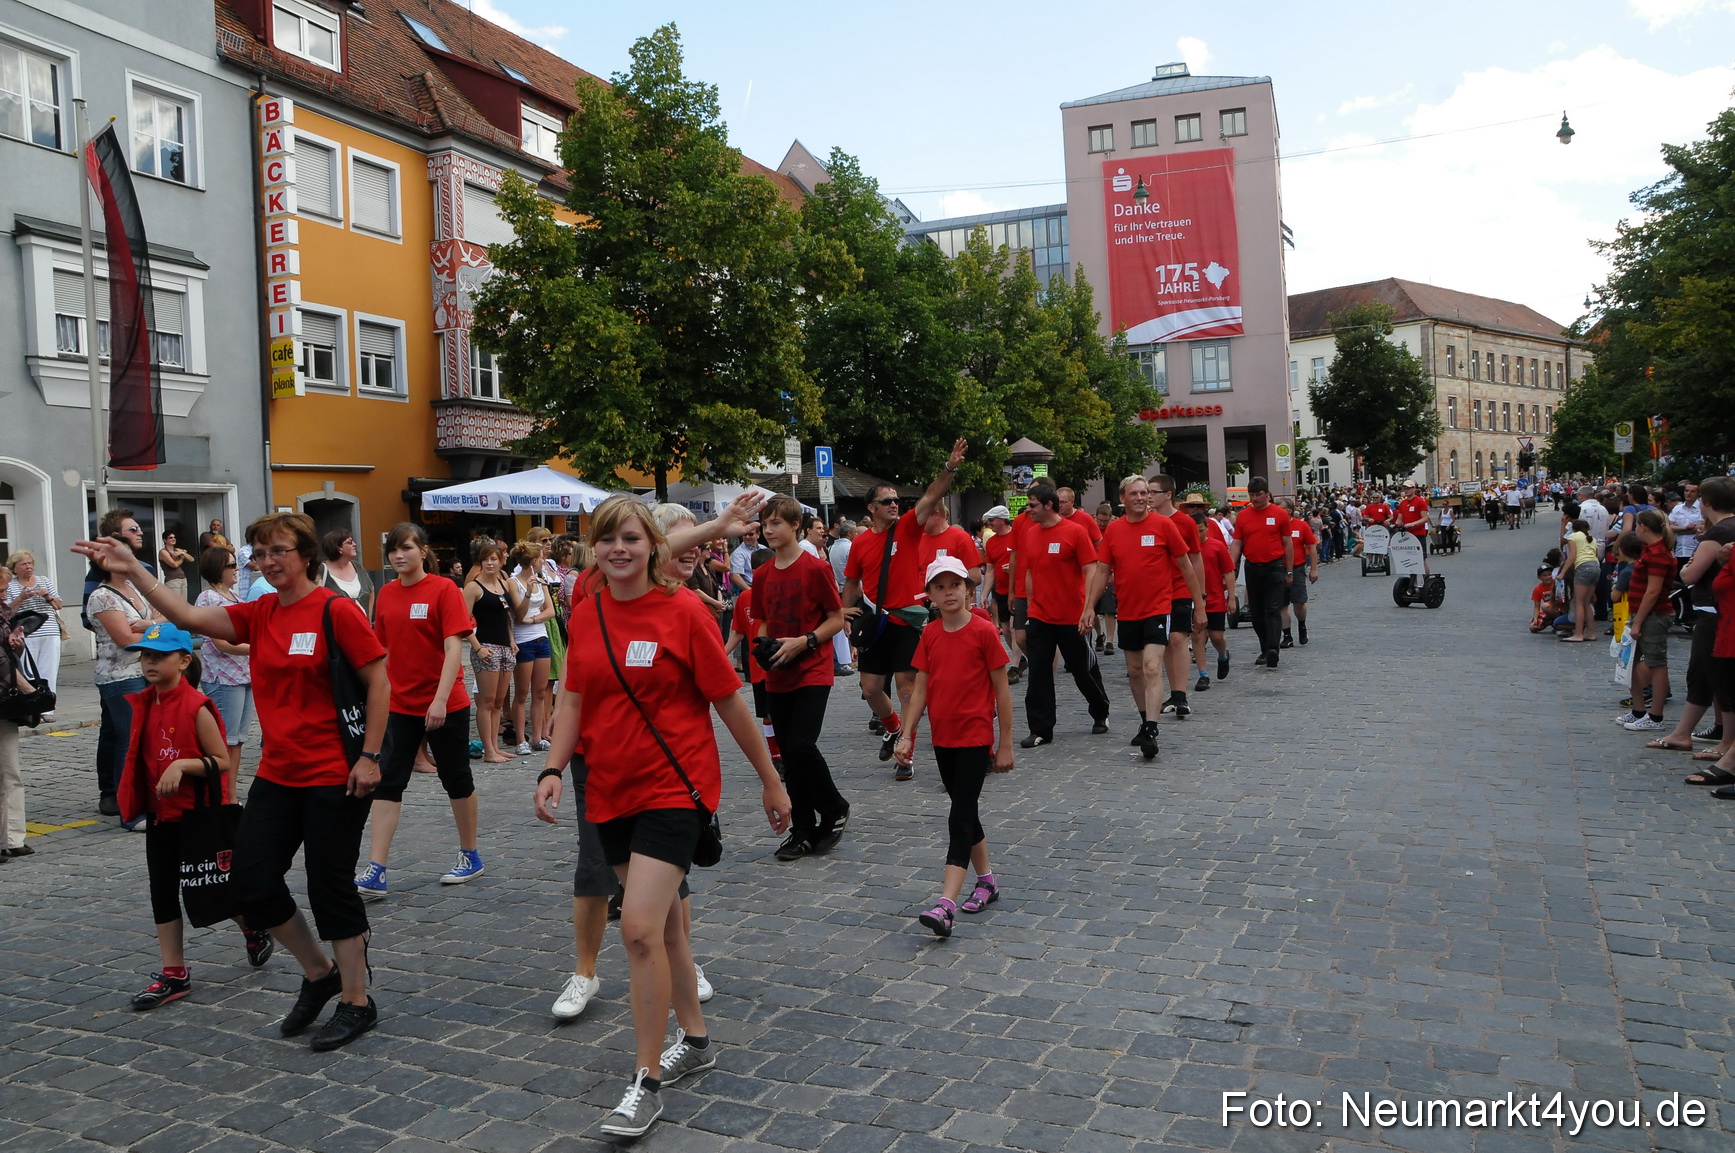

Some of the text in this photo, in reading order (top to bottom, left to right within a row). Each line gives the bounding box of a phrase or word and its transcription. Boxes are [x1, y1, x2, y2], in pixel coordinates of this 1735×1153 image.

[1114, 202, 1160, 217] Danke
[265, 102, 287, 333] BÄCKEREI
[1114, 218, 1192, 232] für Ihr Vertrauen
[1115, 232, 1186, 245] und Ihre Treue.
[1155, 262, 1200, 283] 175
[1157, 281, 1200, 295] JAHRE
[1157, 298, 1183, 306] Sparkasse
[272, 343, 294, 361] café
[273, 376, 295, 393] plank
[1139, 404, 1223, 422] Sparkasse
[819, 451, 829, 473] P
[432, 494, 479, 505] Winkler Bräu
[509, 494, 560, 505] Winkler Bräu
[291, 633, 316, 648] NM
[627, 641, 657, 659] NM
[342, 705, 361, 723] Ich
[197, 859, 217, 872] ein
